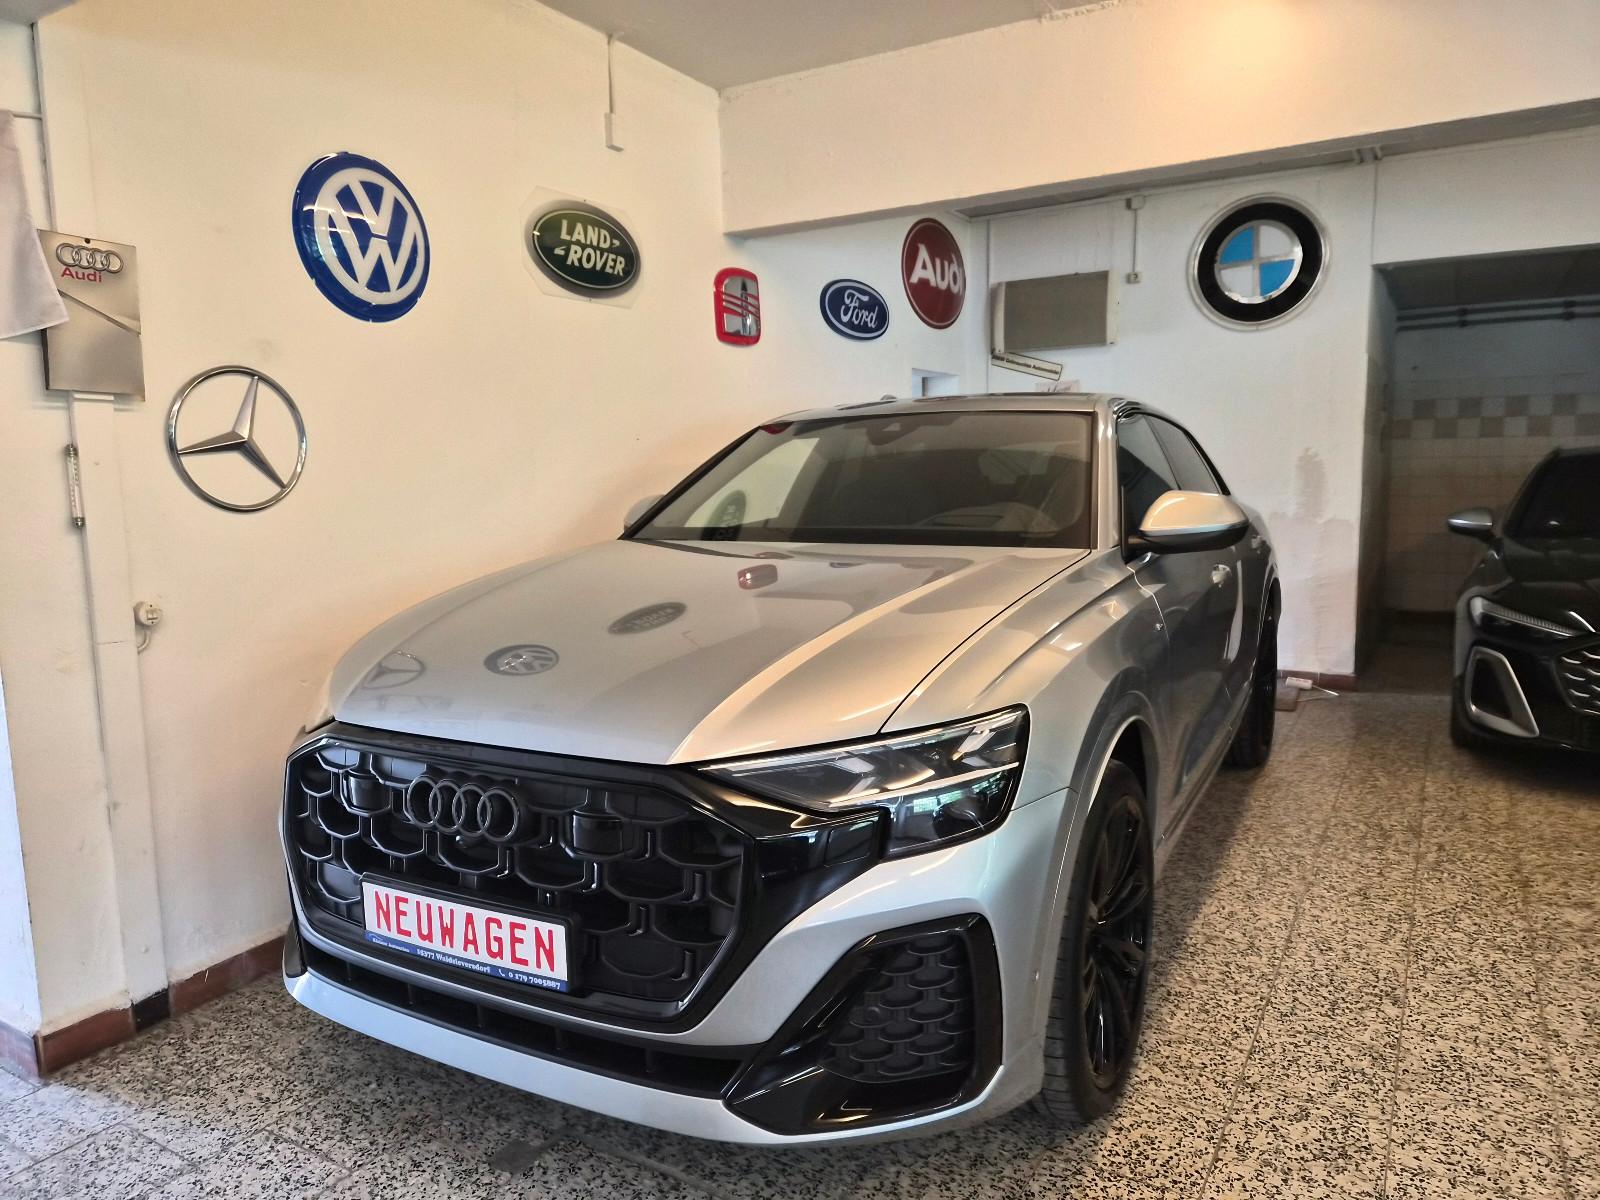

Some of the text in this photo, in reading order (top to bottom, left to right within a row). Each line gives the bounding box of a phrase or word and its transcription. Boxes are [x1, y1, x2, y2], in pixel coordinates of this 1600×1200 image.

[560, 219, 611, 249] LAND
[61, 266, 102, 283] Audi
[566, 244, 625, 277] ROVER
[840, 288, 879, 329] Ford
[375, 890, 555, 973] NEUWAGEN
